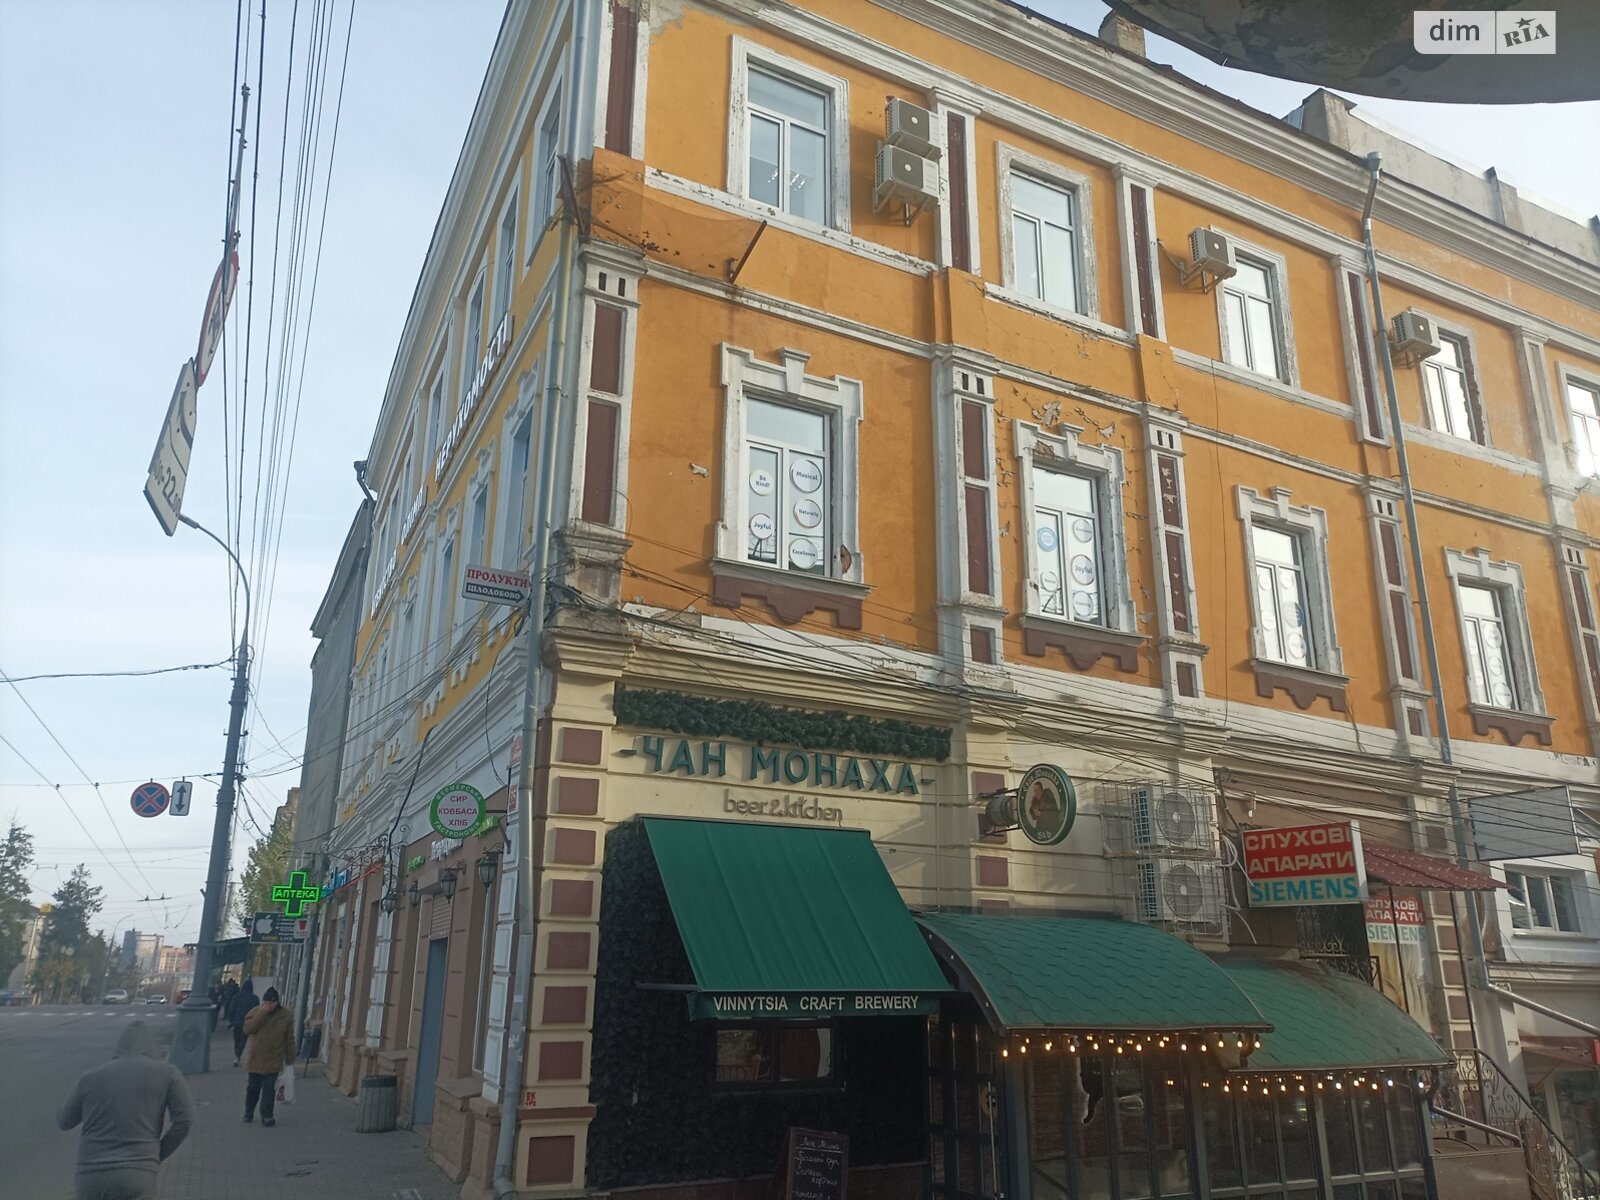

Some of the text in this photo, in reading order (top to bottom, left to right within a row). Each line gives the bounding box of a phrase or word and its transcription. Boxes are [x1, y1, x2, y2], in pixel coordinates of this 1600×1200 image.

[435, 312, 511, 482] НЕРУХОМОСТІ
[796, 471, 818, 481] Musical
[798, 508, 819, 518] Naturally
[753, 521, 772, 531] Joyful
[1074, 565, 1093, 574] Joyful
[467, 568, 528, 588] ПРОДУКТИ
[643, 735, 920, 795] ЧАН МОНАХА
[436, 783, 483, 801] ФЕРМЕРСЬКА
[450, 795, 468, 803] СИР
[438, 807, 478, 815] КОВБАСА
[434, 820, 481, 837] ГАСТРОНОМІЯ
[448, 819, 468, 827] ХЛІБ
[1245, 827, 1352, 851] СЛУХОВІ
[1249, 851, 1354, 874] АПАРАТИ
[275, 889, 316, 899] АПТЕКА
[1250, 877, 1359, 902] SIEMENS
[1368, 899, 1419, 911] СЛУХОВІ
[713, 995, 919, 1011] VINNYTSIA CRAFT BREWERY
